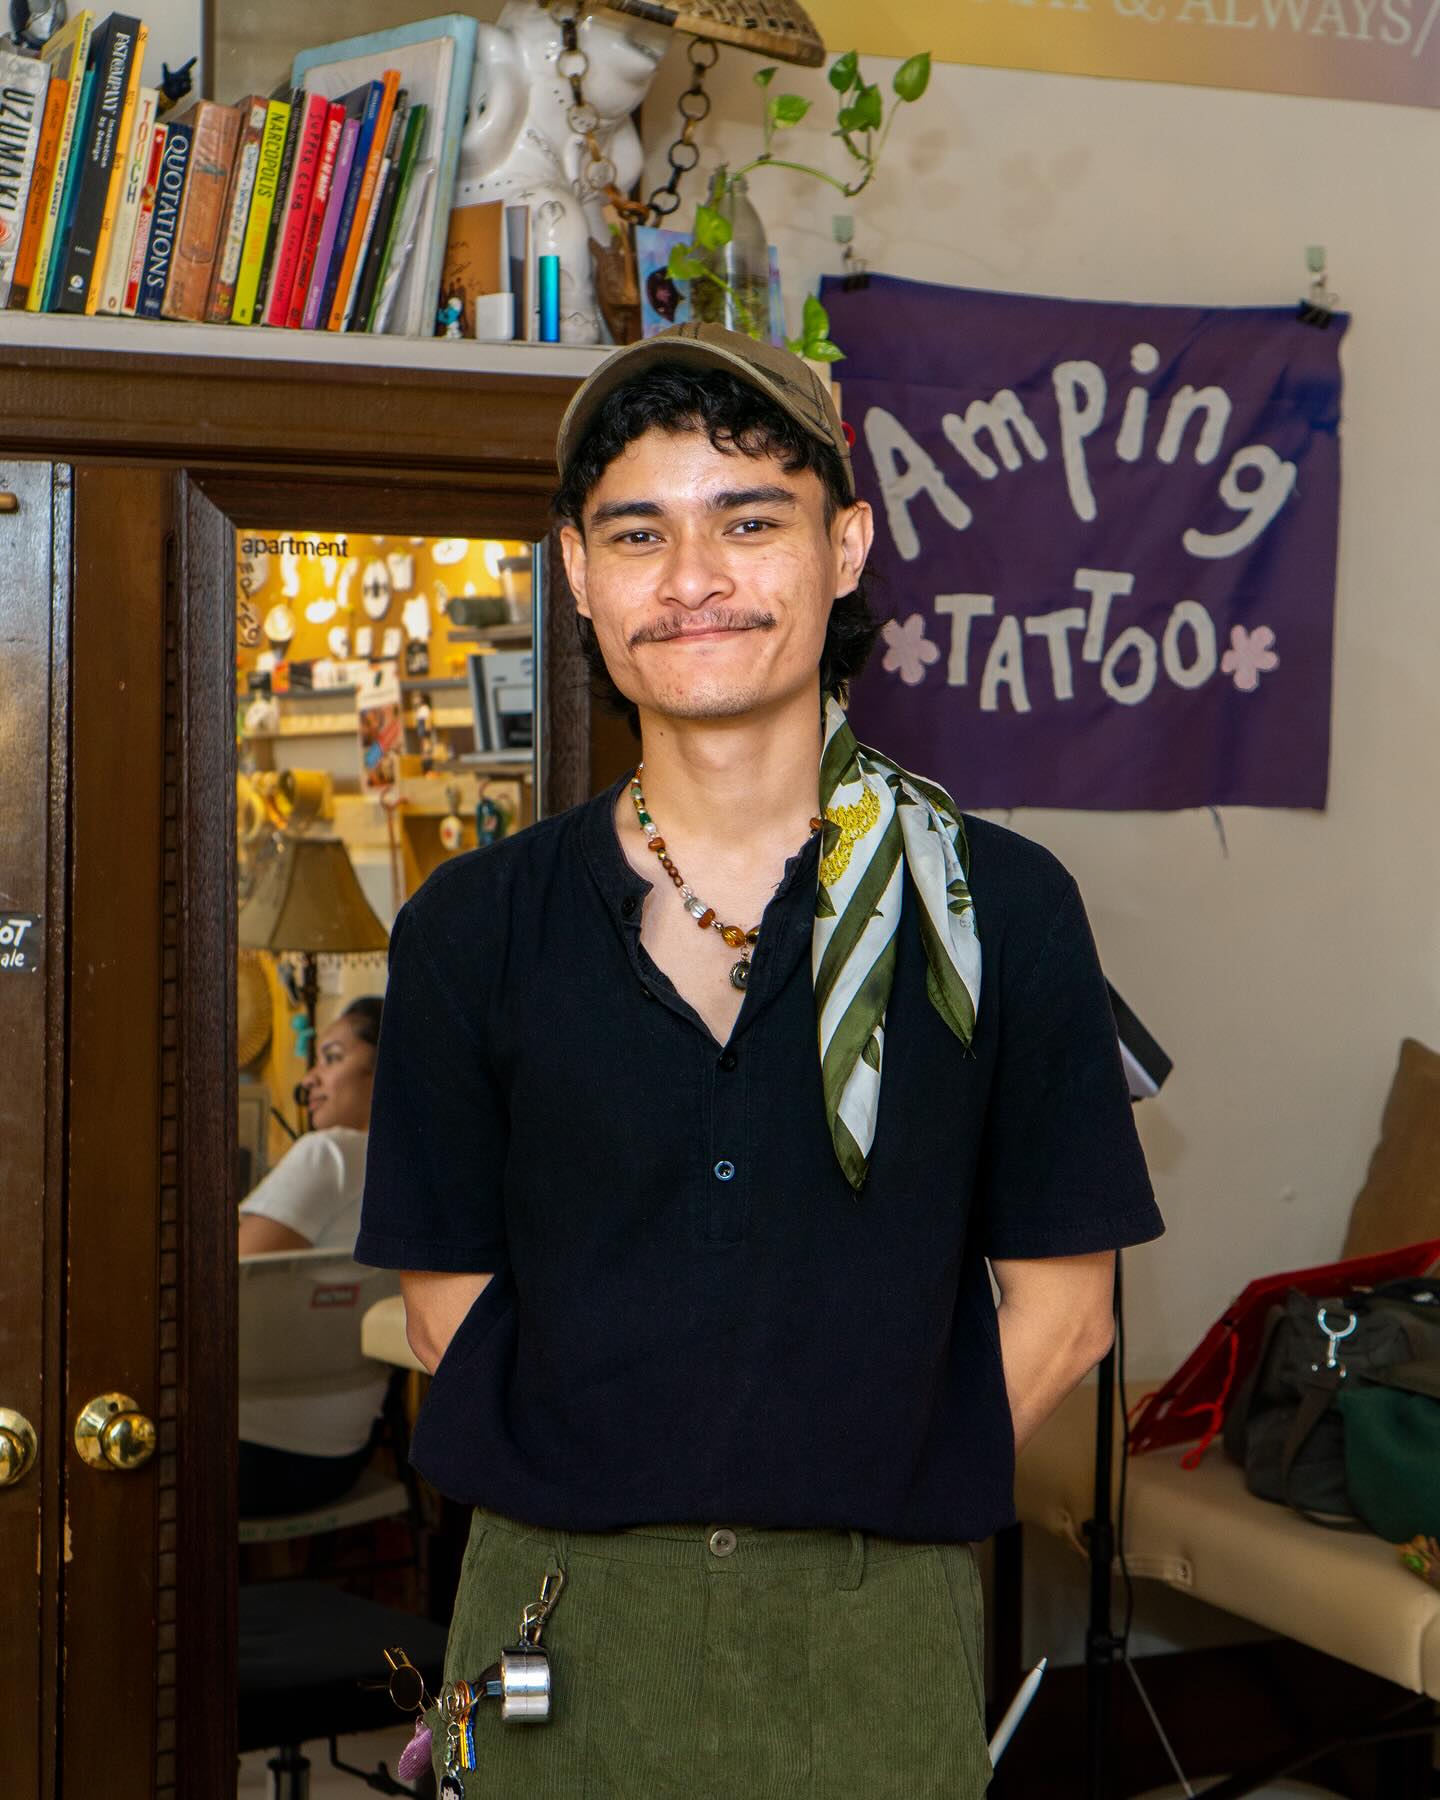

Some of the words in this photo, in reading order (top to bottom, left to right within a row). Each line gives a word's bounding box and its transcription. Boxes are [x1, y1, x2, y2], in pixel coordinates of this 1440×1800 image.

[92, 129, 106, 162] Design
[100, 119, 116, 169] Innovation
[126, 99, 152, 205] TOUCH
[256, 111, 287, 199] NARCOPOLIS
[146, 134, 190, 289] QUOTATIONS
[863, 342, 1297, 561] Amping
[241, 537, 349, 559] apartment
[934, 568, 1217, 714] TATTOO
[0, 919, 32, 947] OT
